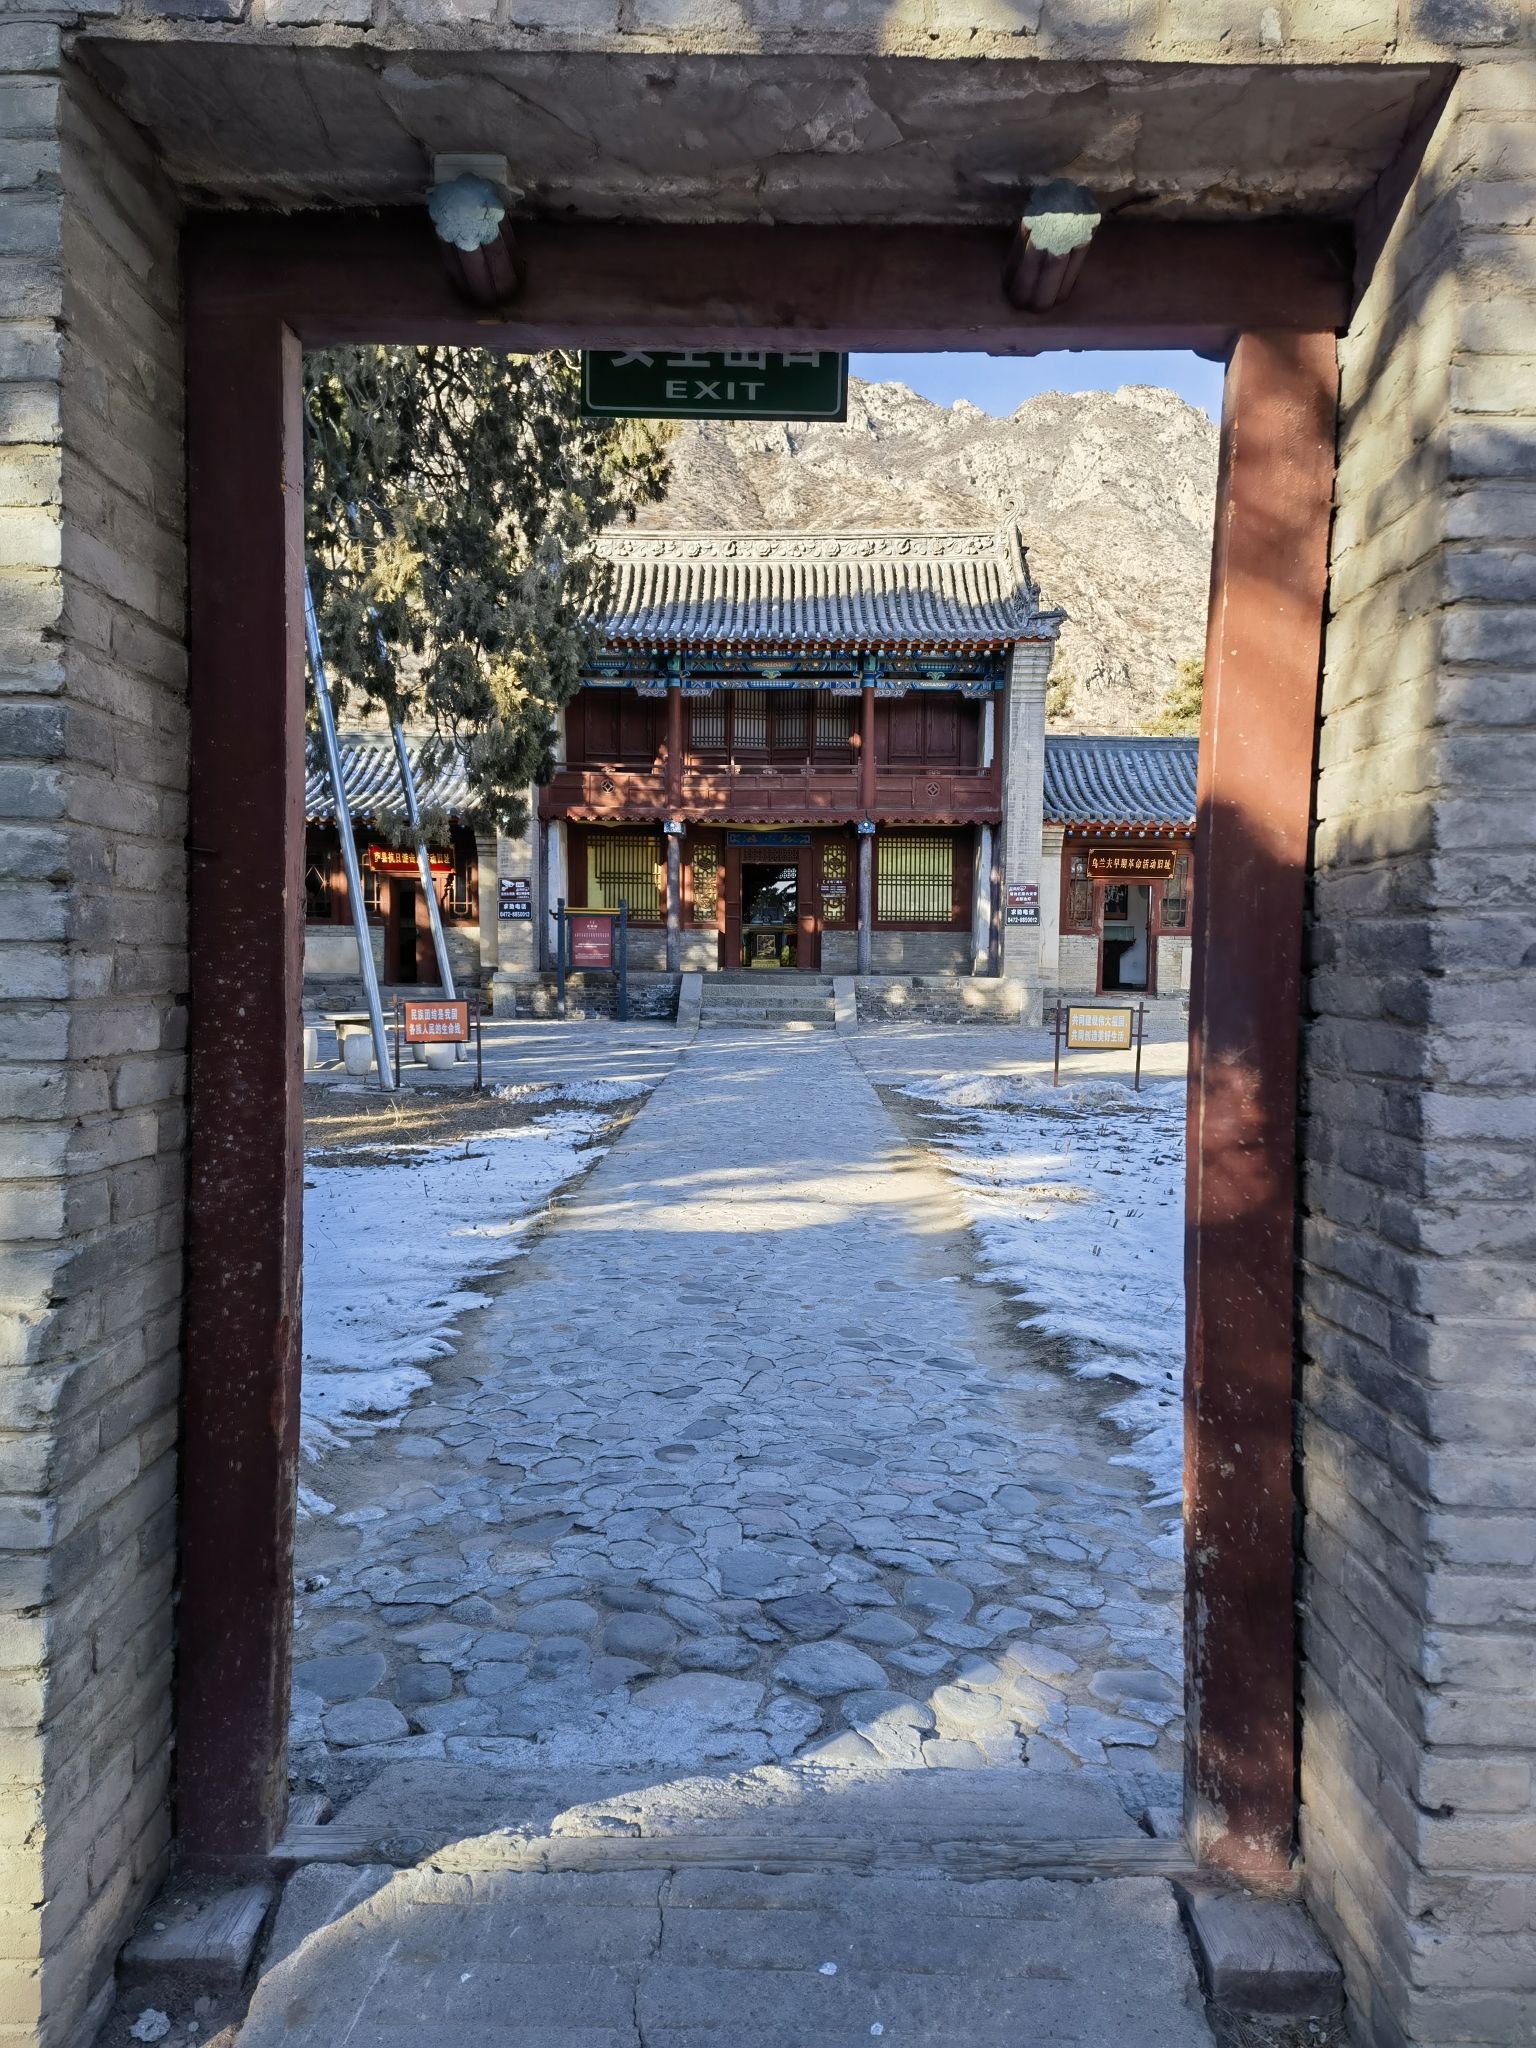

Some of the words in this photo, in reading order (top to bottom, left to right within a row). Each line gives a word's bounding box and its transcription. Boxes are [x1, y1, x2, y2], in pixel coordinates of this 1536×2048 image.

[666, 380, 765, 400] EXIT
[374, 852, 450, 864] 萨县抗日游击动旧址
[1092, 858, 1171, 870] 乌兰夫早期革命活动旧址
[410, 1008, 458, 1020] 民族团结是我国
